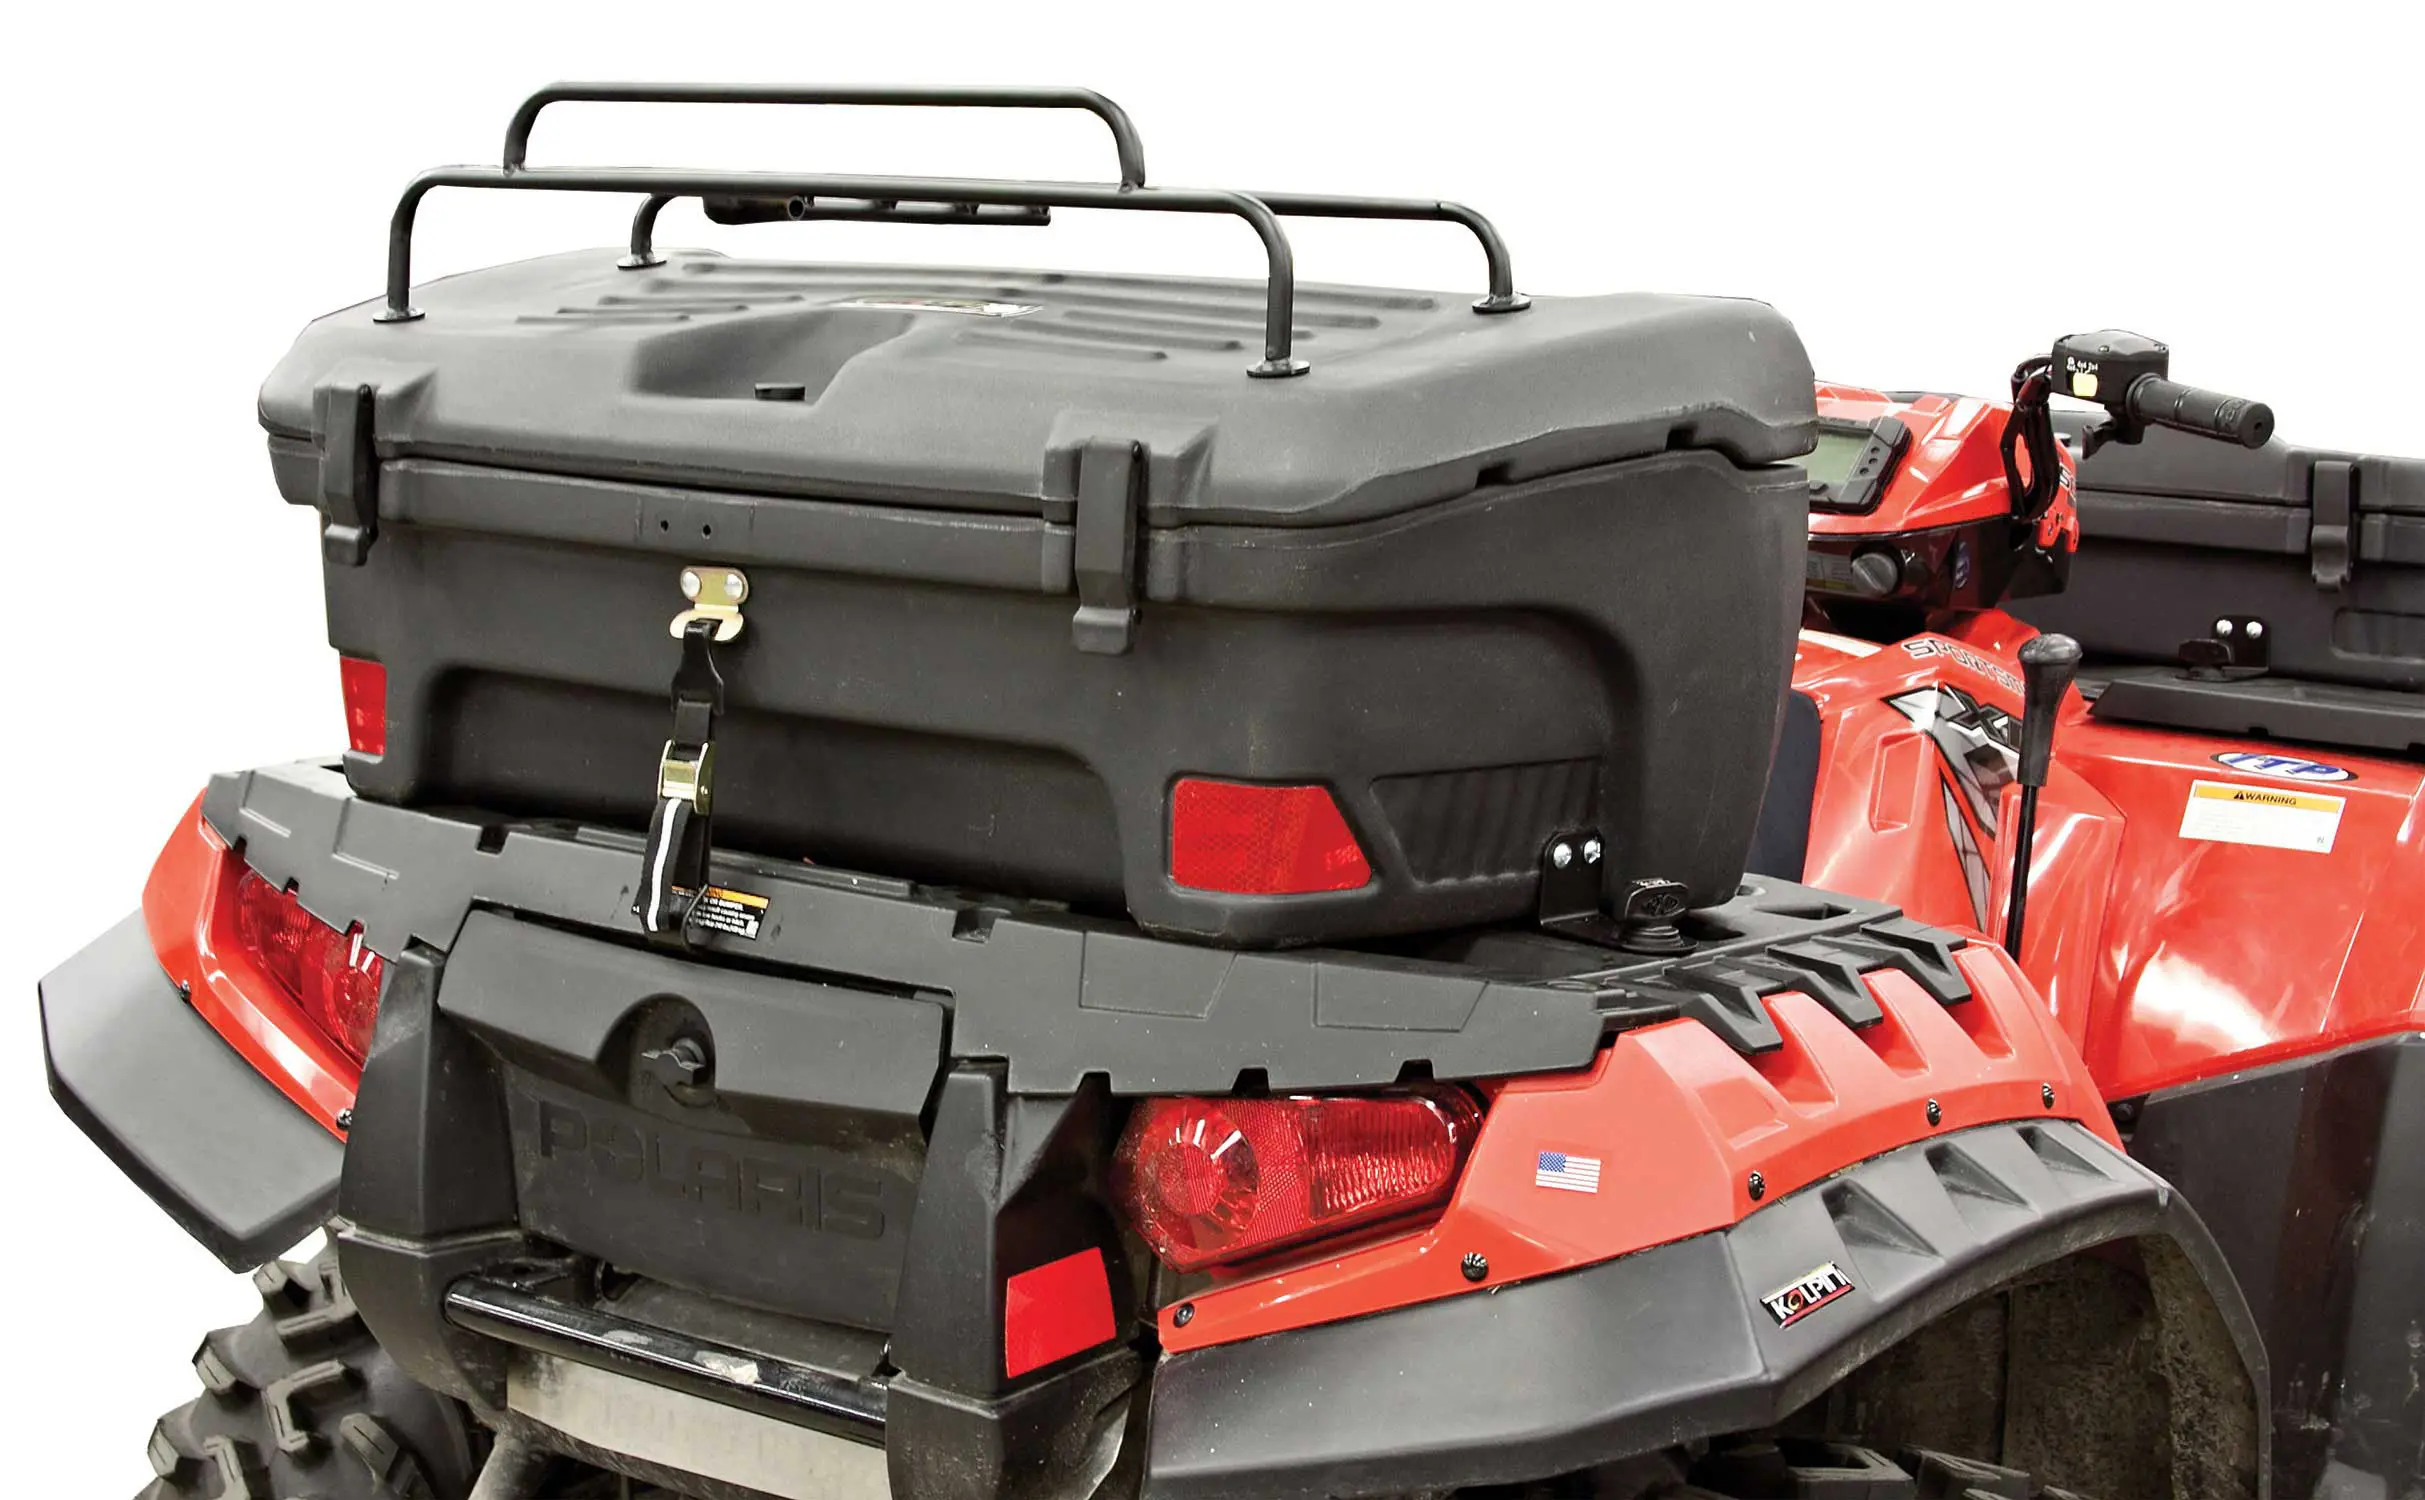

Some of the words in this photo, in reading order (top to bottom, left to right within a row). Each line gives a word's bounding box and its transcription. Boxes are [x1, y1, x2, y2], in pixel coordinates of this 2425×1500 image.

[1901, 637, 2025, 696] SPORTSM
[2245, 792, 2297, 806] WARNING
[539, 1099, 886, 1240] POLARIS
[1769, 1264, 1849, 1320] KOLPIN
